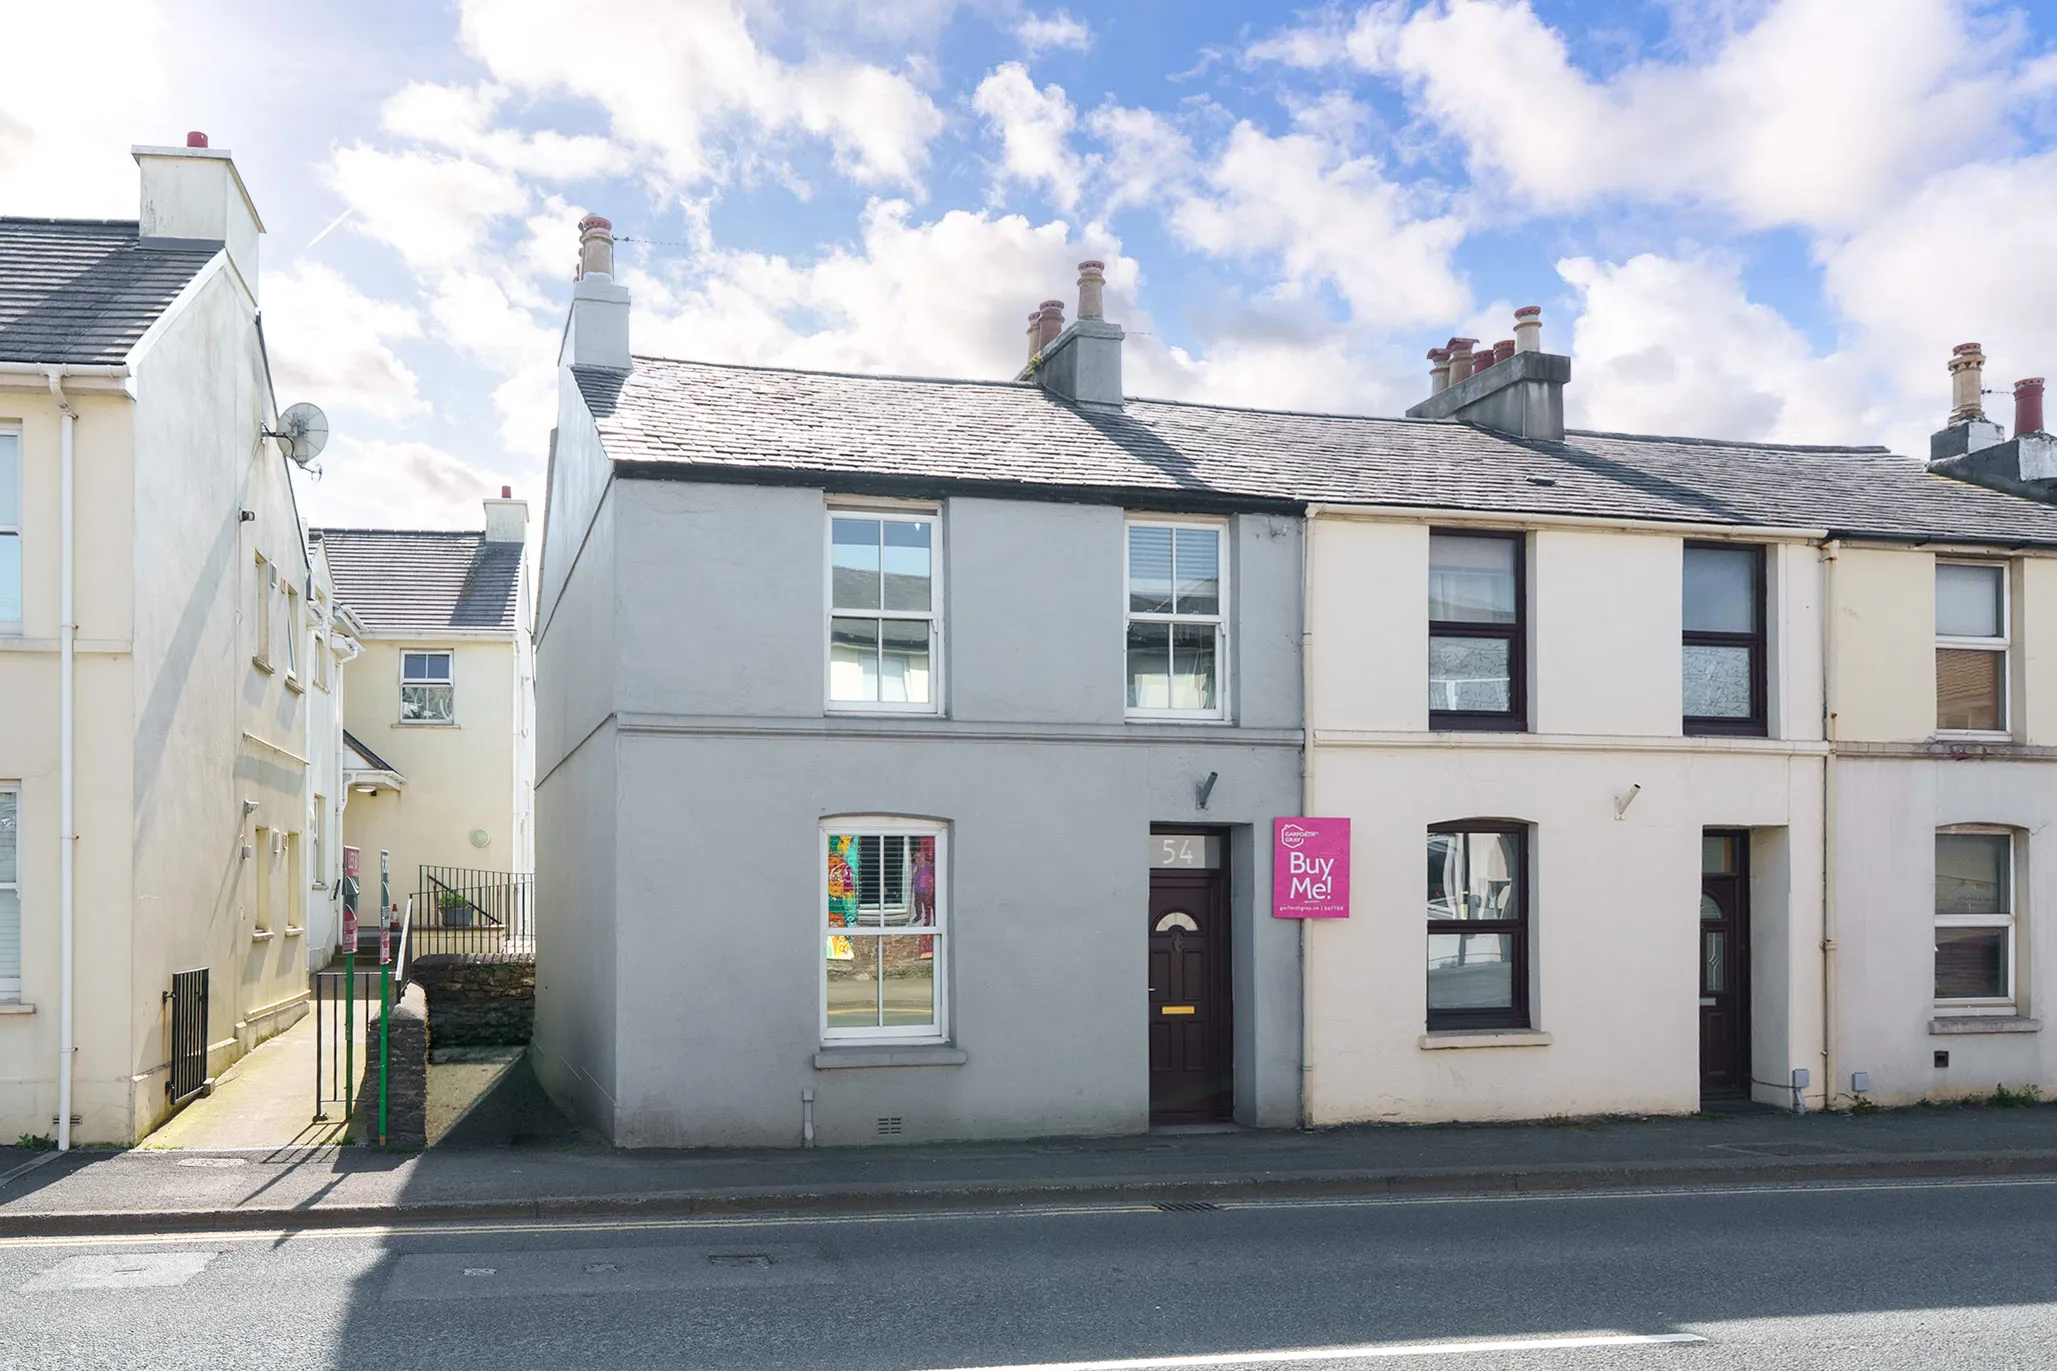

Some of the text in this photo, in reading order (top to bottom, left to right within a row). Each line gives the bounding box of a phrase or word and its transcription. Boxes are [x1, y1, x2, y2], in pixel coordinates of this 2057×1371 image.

[1163, 839, 1193, 864] 54
[1290, 852, 1334, 881] Buy
[1289, 876, 1332, 900] Me!
